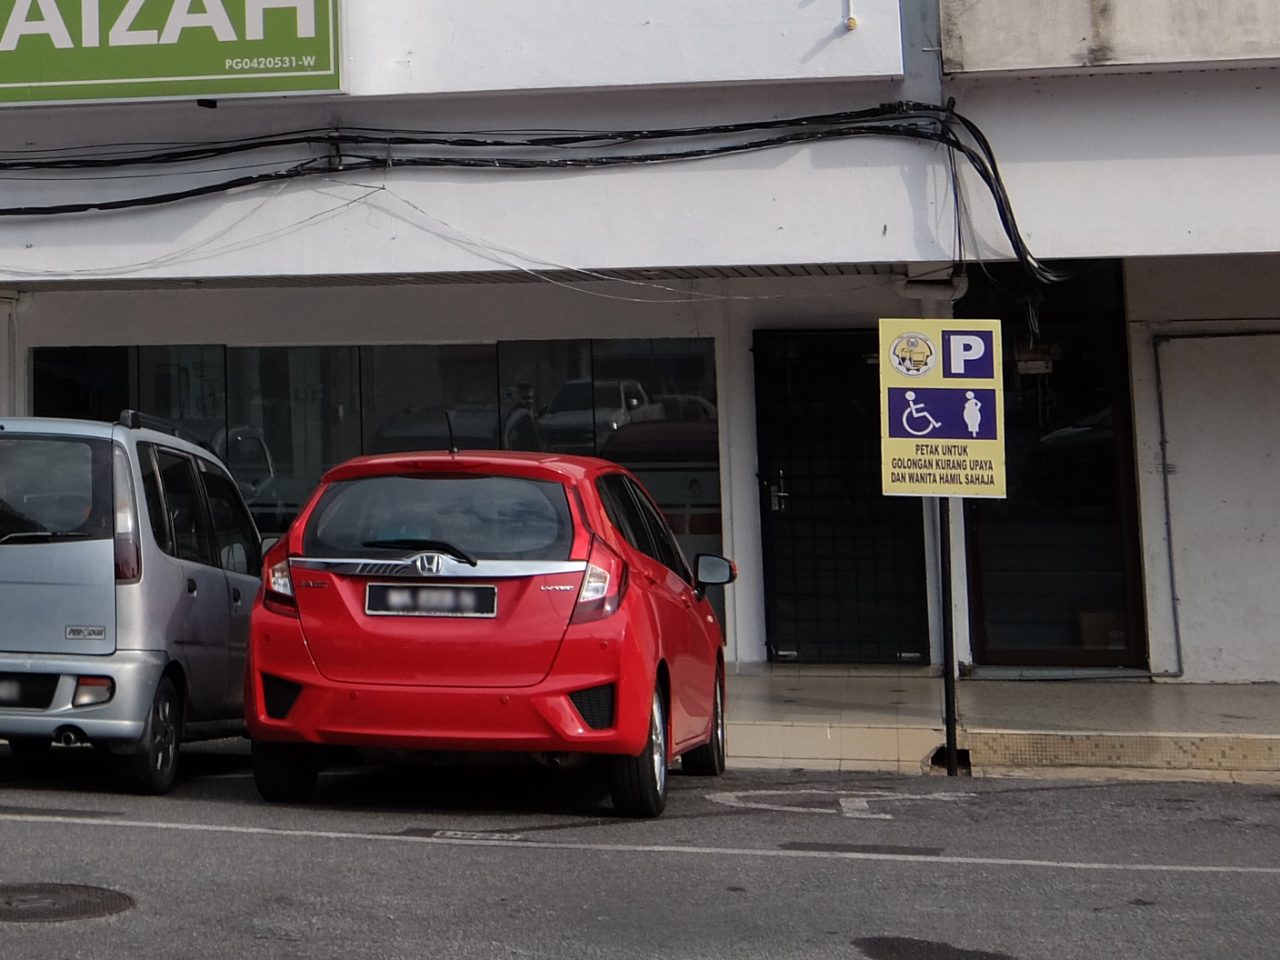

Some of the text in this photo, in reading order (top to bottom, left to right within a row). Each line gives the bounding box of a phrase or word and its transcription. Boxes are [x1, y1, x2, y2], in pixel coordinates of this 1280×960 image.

[225, 55, 316, 70] PG0420531-W
[950, 335, 985, 374] P
[915, 444, 968, 456] PETAK UNTUK
[892, 458, 993, 471] GOLONGAN KURANG UPAYA
[891, 472, 995, 485] DAN WANITA HAMIL SAHAJA
